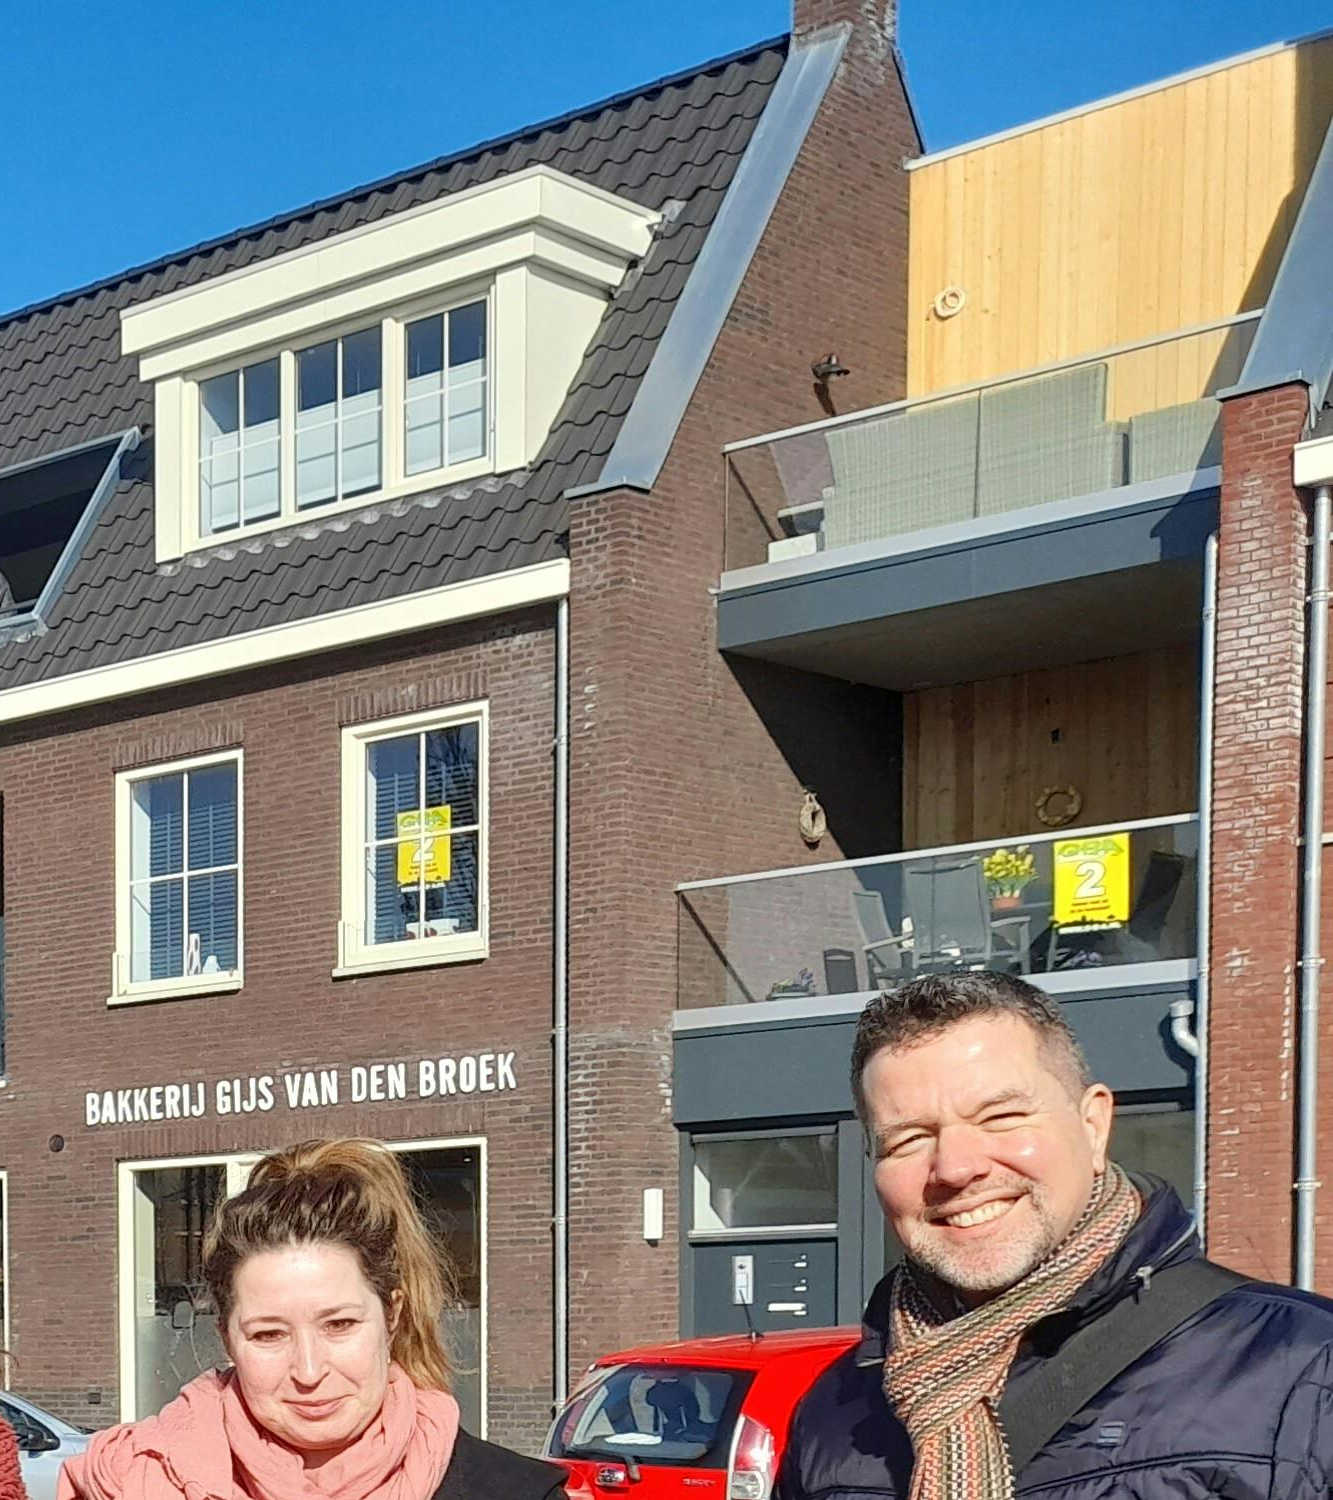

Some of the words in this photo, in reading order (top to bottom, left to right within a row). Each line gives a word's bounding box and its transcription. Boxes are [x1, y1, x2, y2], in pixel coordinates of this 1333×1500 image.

[1075, 861, 1106, 898] 2
[85, 1082, 206, 1126] BAKKERIJ
[216, 1076, 274, 1115] GIJS
[284, 1068, 338, 1109] VAN
[351, 1062, 406, 1103] DEN
[418, 1051, 518, 1098] BROEK
